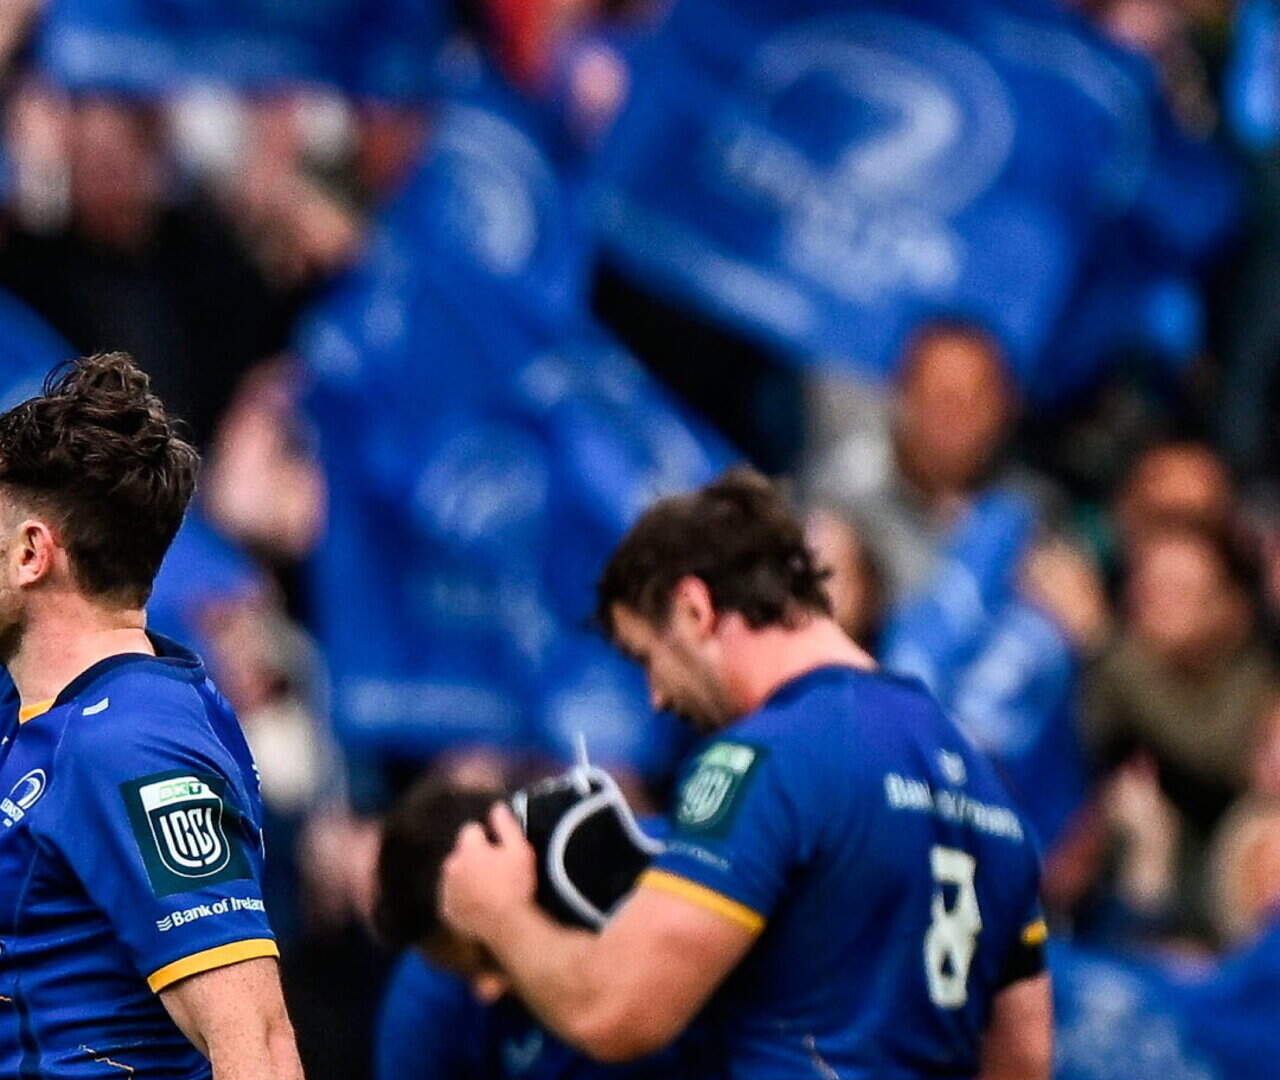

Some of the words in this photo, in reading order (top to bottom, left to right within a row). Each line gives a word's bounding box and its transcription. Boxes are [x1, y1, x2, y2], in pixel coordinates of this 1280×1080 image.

[171, 904, 213, 927] Bank
[212, 898, 229, 914] of
[230, 896, 266, 913] Irelan
[922, 845, 983, 1009] 8
